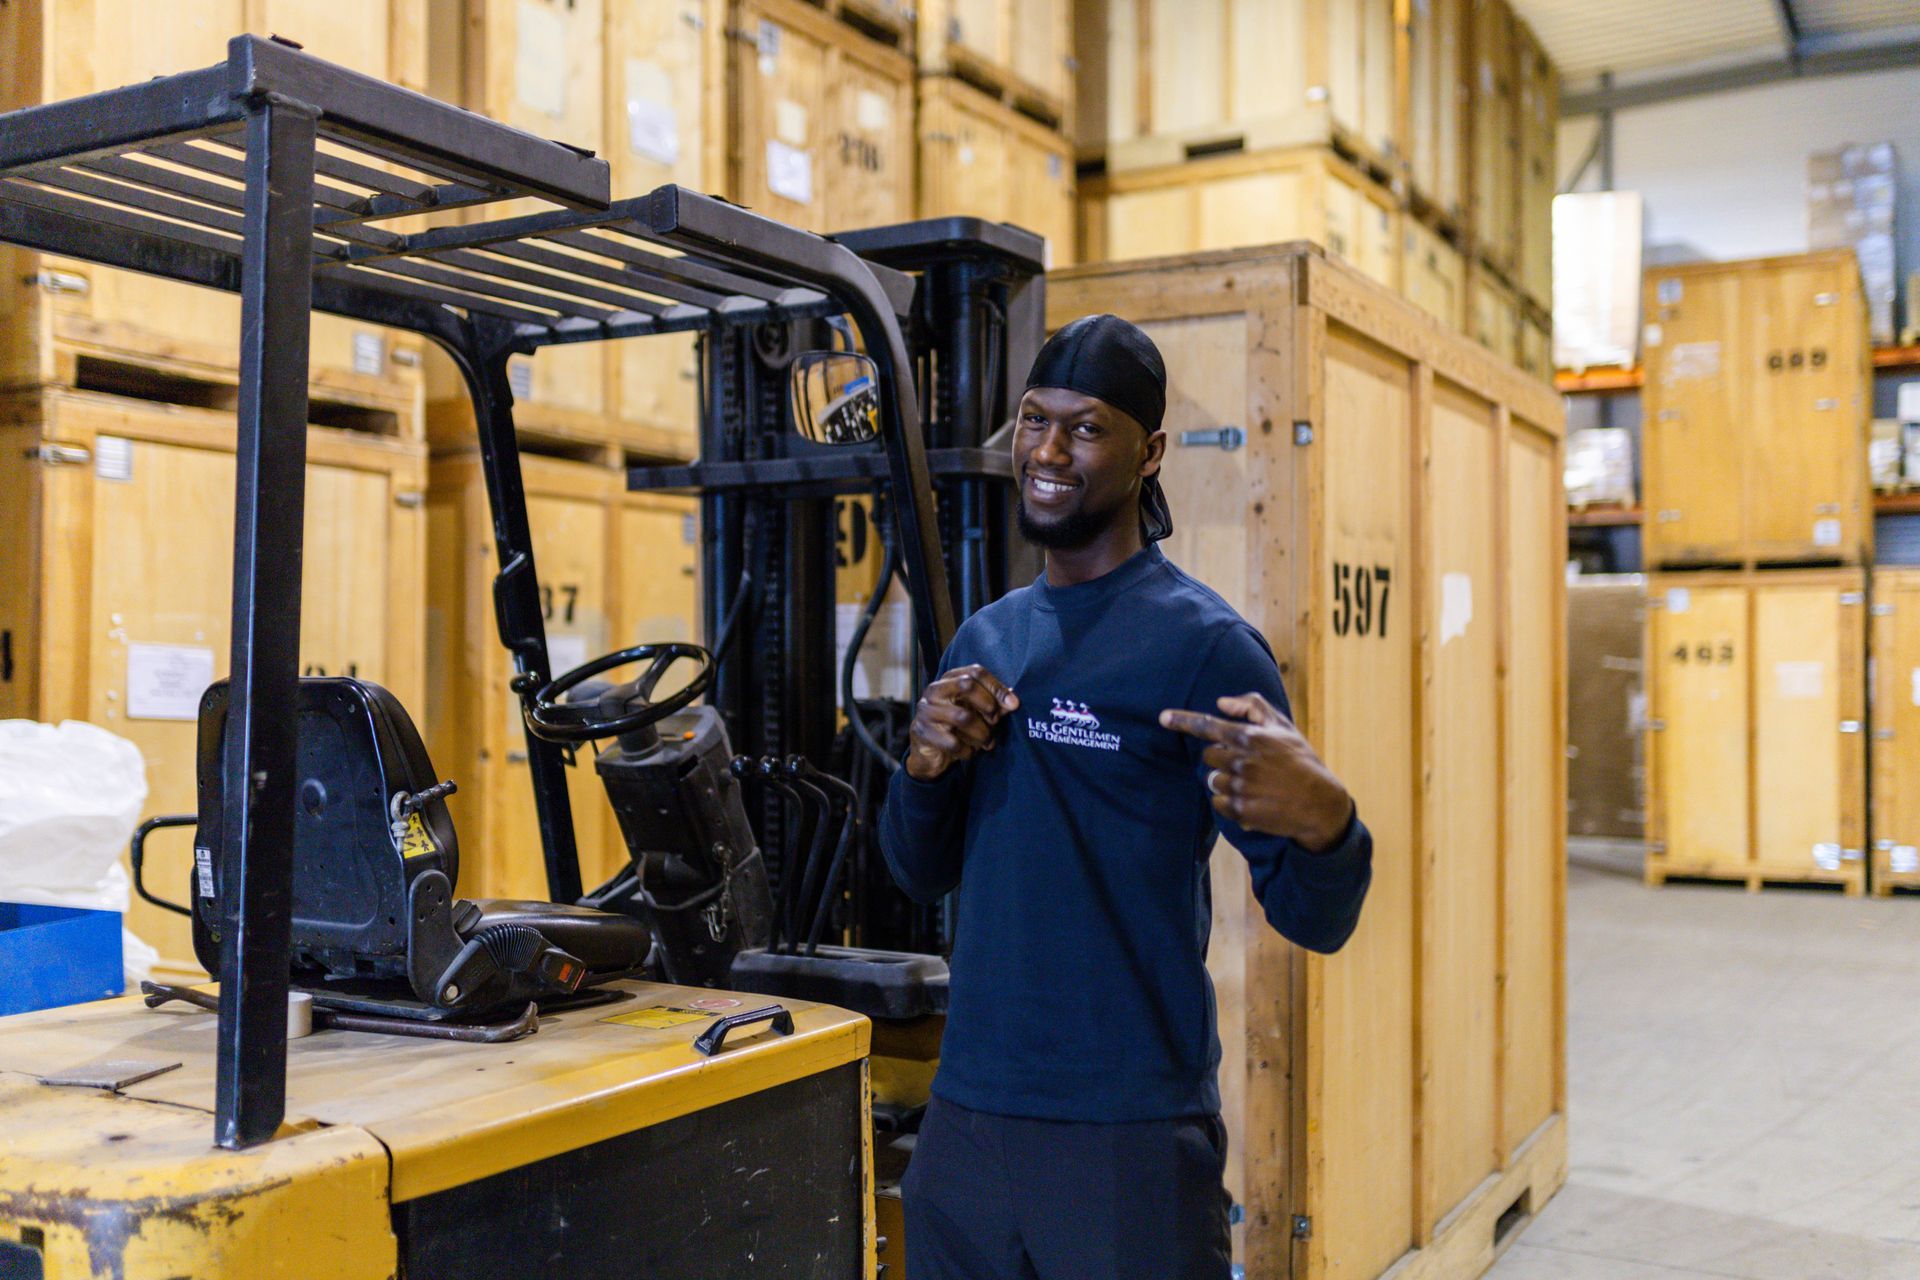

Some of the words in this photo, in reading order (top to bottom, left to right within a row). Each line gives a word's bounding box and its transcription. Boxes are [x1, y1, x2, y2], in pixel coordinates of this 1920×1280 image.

[1333, 561, 1390, 638] 597
[1027, 717, 1048, 732] LES
[1050, 721, 1121, 744] GENTLEMEN
[1028, 729, 1043, 739] DU
